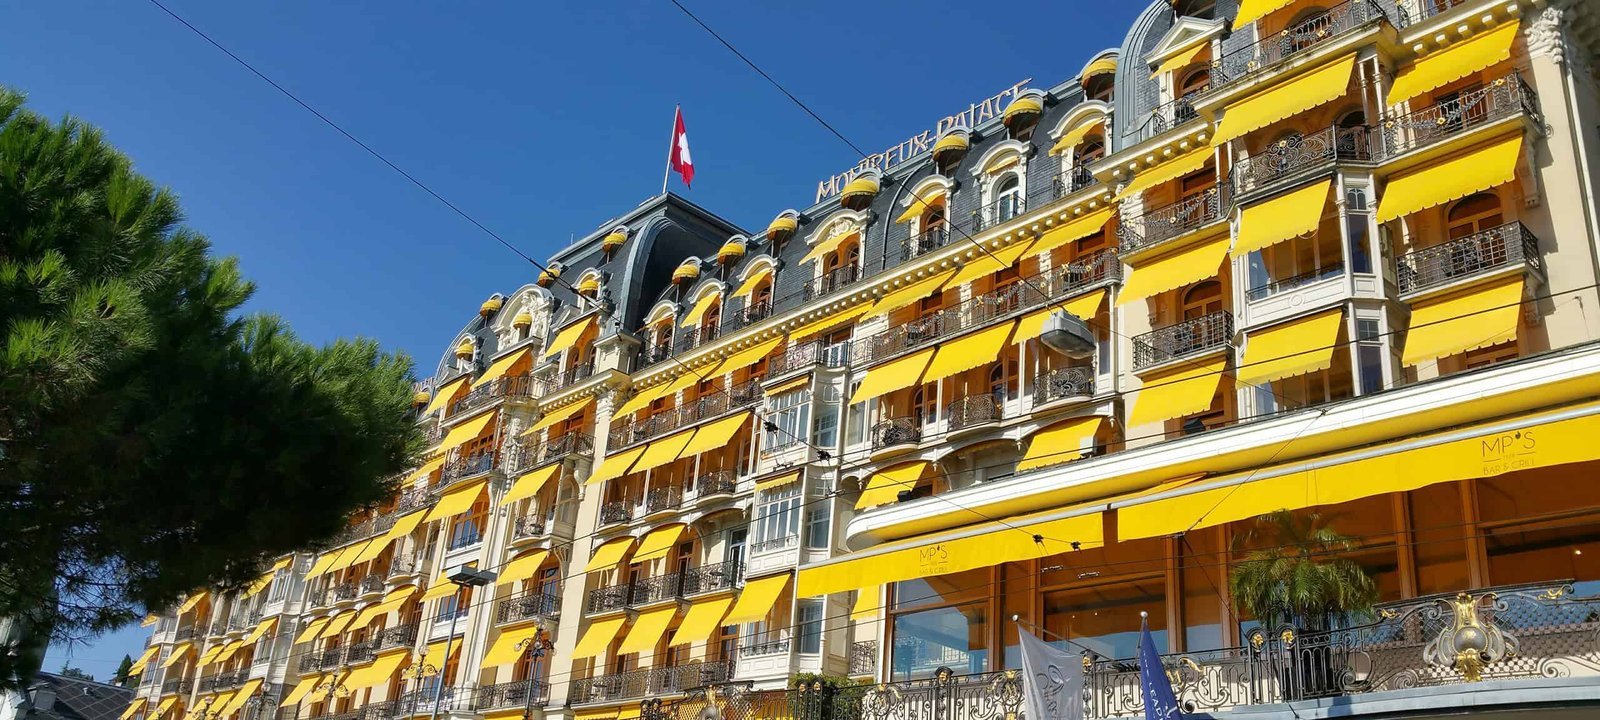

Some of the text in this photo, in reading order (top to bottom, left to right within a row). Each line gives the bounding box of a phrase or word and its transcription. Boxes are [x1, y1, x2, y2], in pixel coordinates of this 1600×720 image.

[1482, 430, 1536, 457] MP'S
[1483, 465, 1501, 476] BAR
[1511, 458, 1535, 470] GRILL
[919, 544, 948, 562] MP'S
[1149, 682, 1164, 720] LEAD
